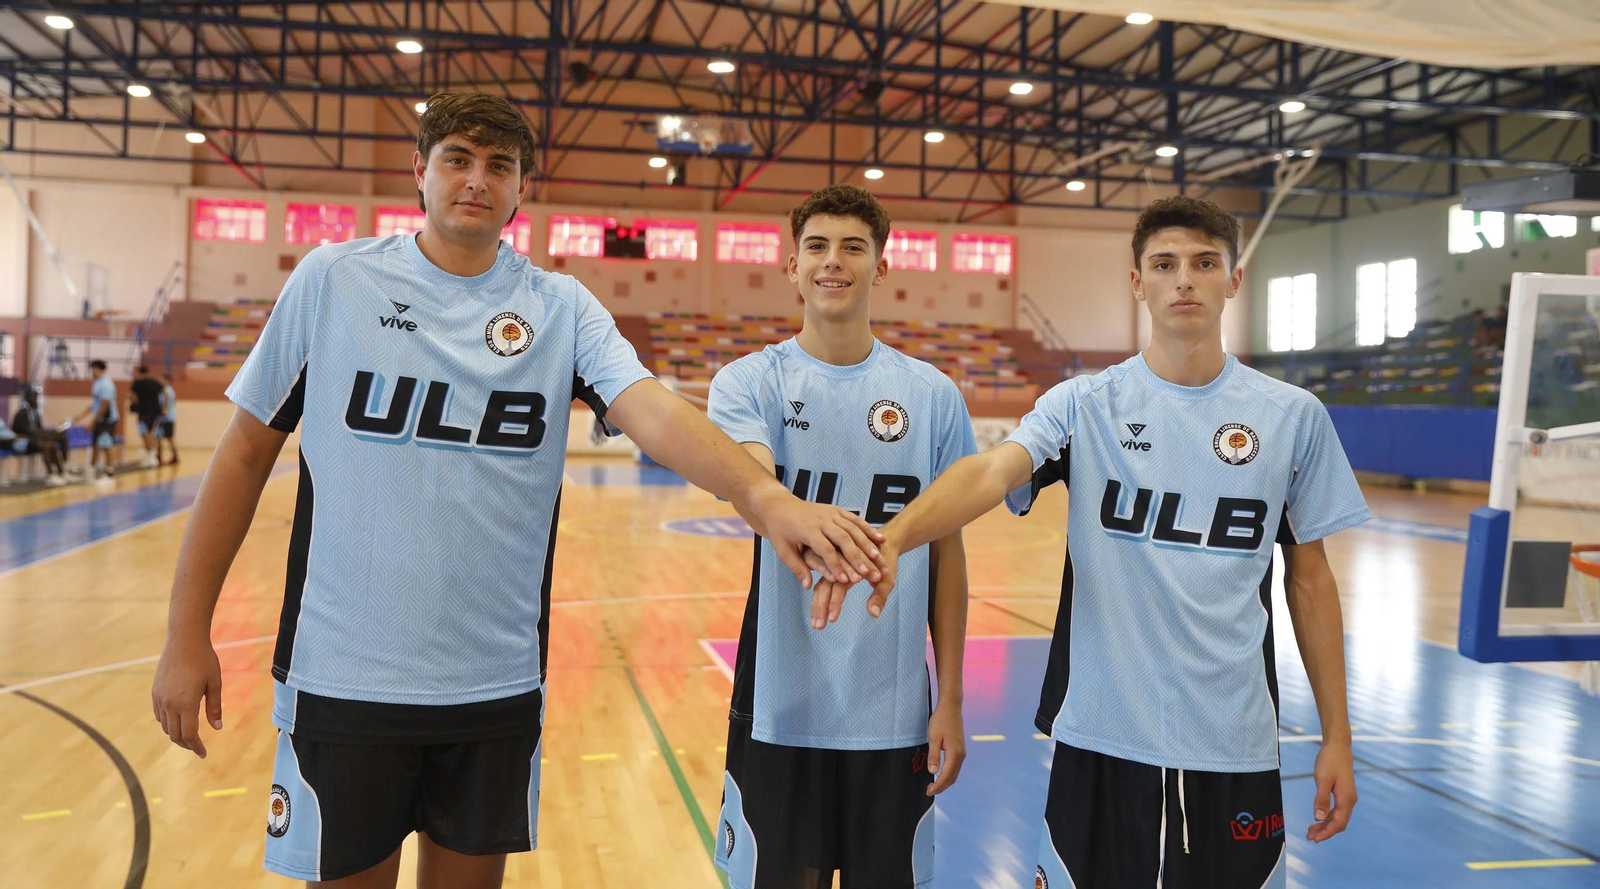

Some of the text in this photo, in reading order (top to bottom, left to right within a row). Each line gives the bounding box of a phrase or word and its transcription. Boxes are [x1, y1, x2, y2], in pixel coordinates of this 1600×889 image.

[379, 315, 418, 332] vive
[344, 370, 547, 455] ULB
[783, 416, 810, 431] vive
[1120, 439, 1152, 452] vive
[1100, 479, 1269, 555] ULB
